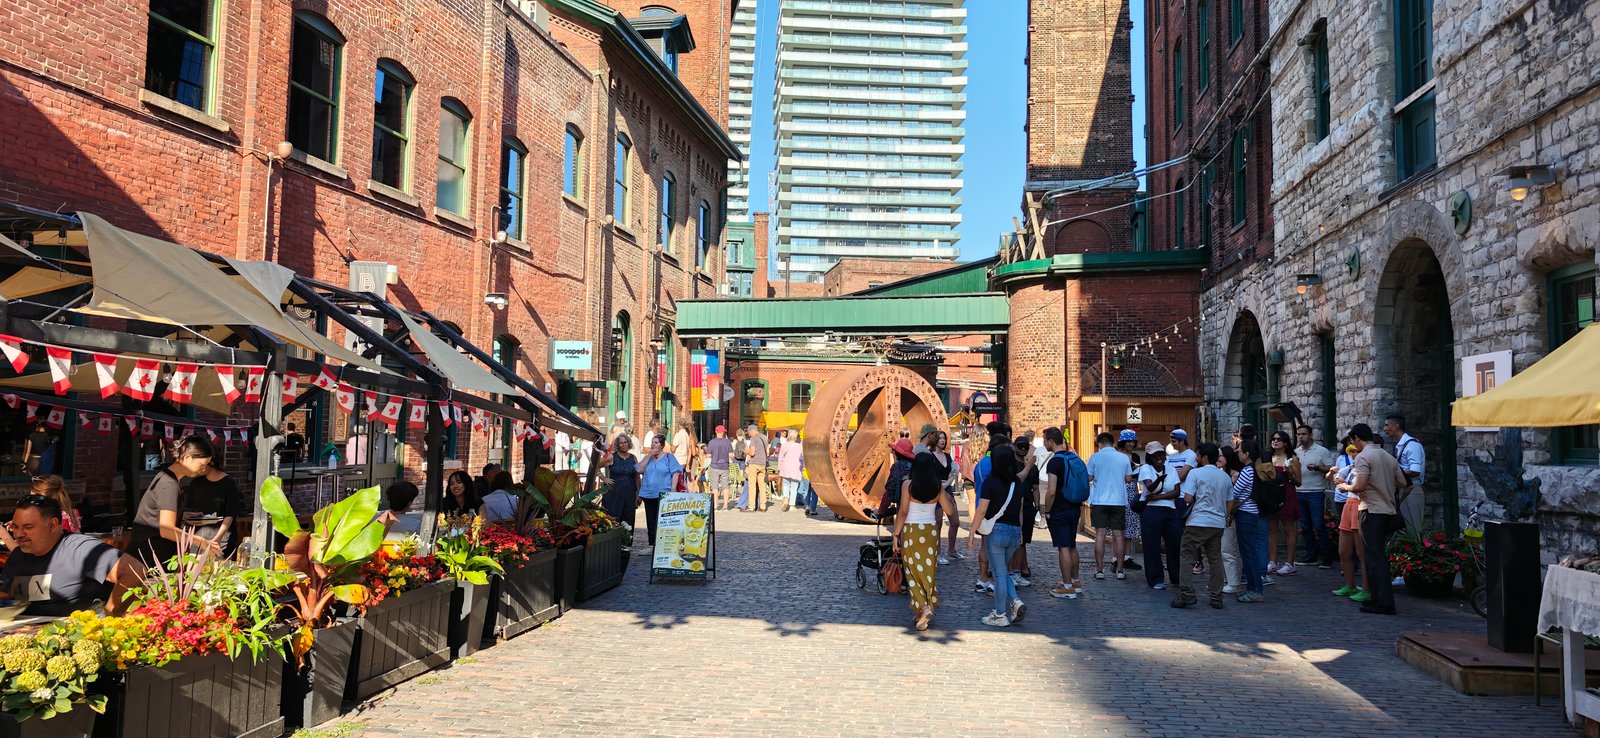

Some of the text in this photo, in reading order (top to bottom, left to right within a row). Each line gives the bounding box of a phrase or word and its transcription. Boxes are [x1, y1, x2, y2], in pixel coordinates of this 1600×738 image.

[556, 347, 585, 355] scooped
[702, 366, 710, 380] ice
[660, 500, 707, 513] LEMONADE
